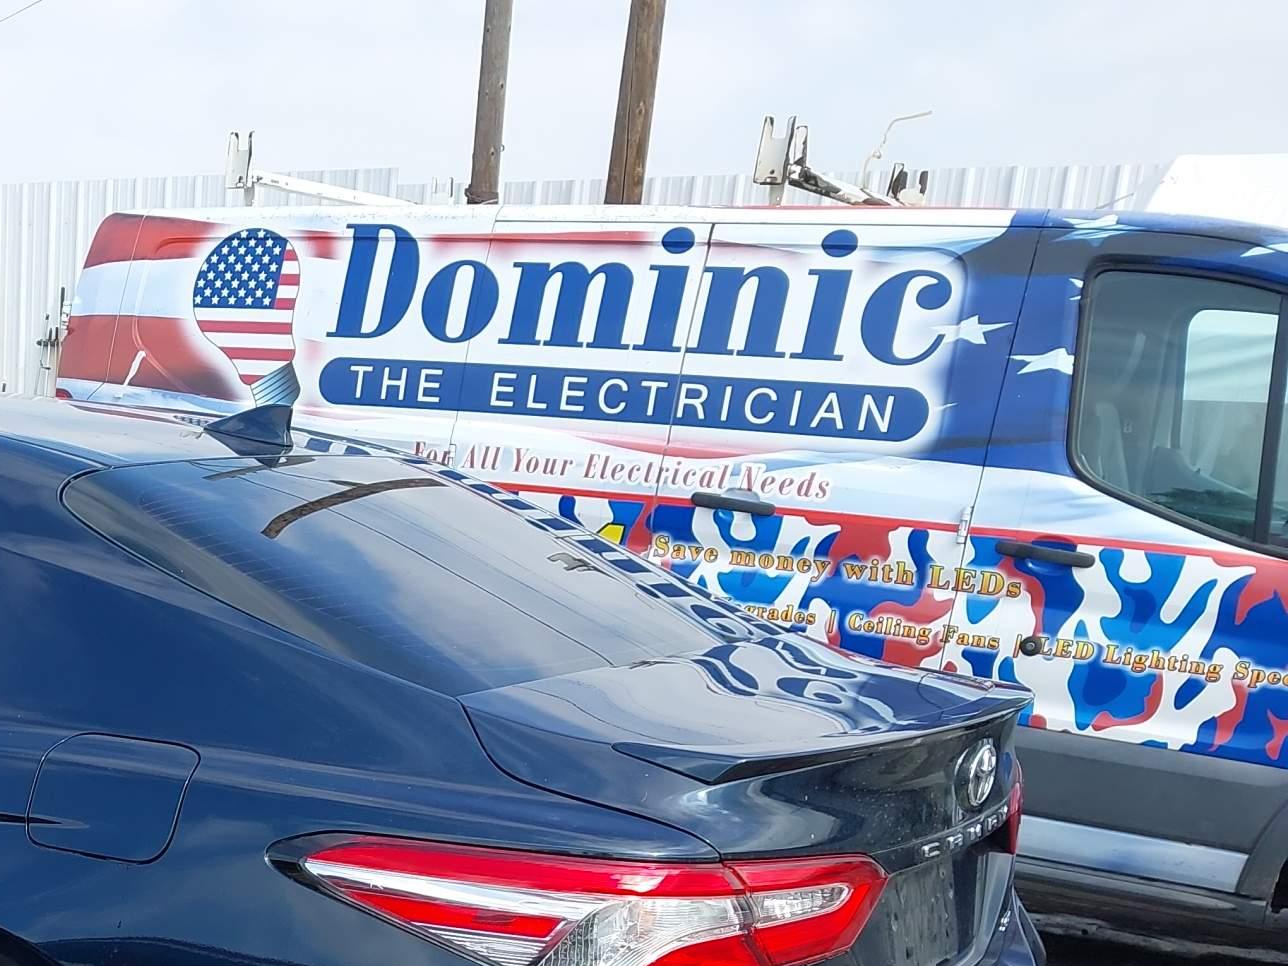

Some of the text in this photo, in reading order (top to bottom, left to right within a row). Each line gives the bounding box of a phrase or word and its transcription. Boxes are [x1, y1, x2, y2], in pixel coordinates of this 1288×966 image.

[326, 224, 953, 365] Dominic
[350, 365, 895, 433] THE ELECTRICIAN
[462, 443, 502, 470] All
[512, 447, 574, 476] Your
[583, 453, 730, 489] Electrical
[739, 465, 830, 499] Needs
[653, 534, 1022, 598] Save money with LEDs
[848, 612, 932, 645] Ceiling
[940, 624, 1000, 650] Fans
[1037, 636, 1094, 661] LED
[1103, 643, 1224, 682] Lighting
